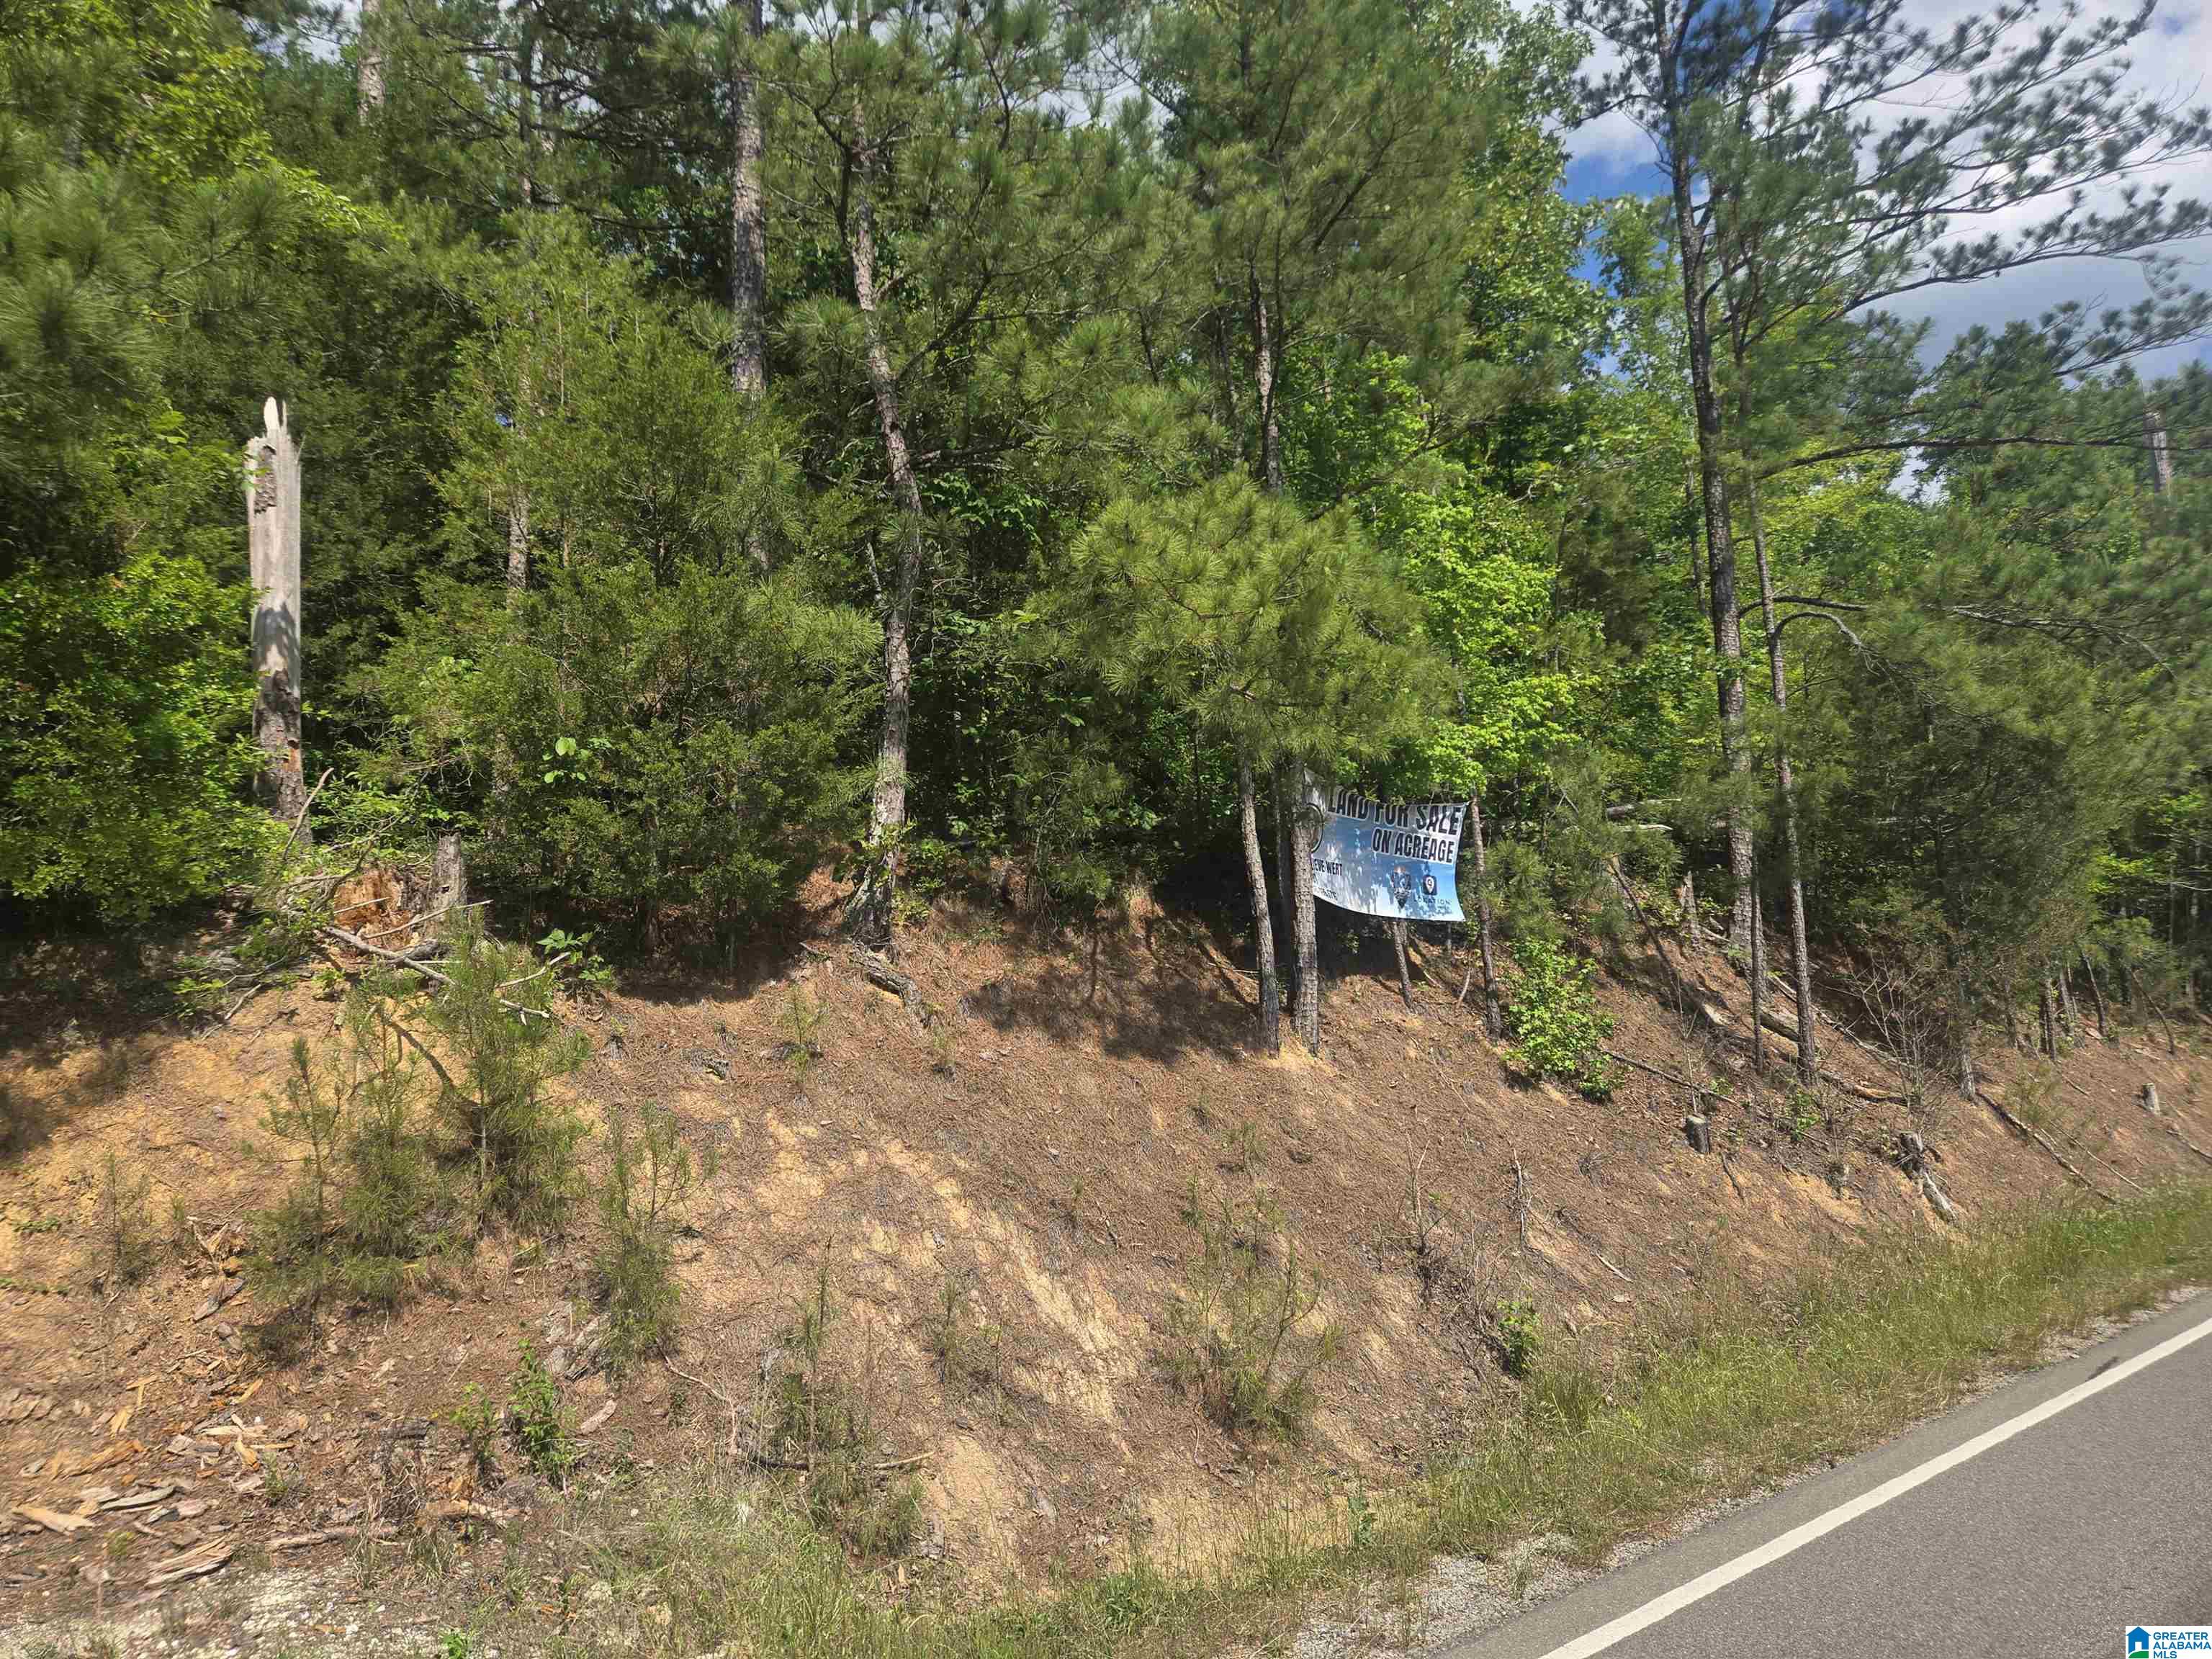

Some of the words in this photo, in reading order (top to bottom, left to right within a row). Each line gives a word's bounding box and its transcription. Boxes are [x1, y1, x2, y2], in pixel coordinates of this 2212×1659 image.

[1328, 790, 1368, 819] LAND
[1375, 802, 1408, 827] FOR
[1416, 805, 1461, 835] SALE
[1372, 829, 1390, 853] ON
[1394, 833, 1454, 863] ACREAGE
[1326, 860, 1342, 876] WERT
